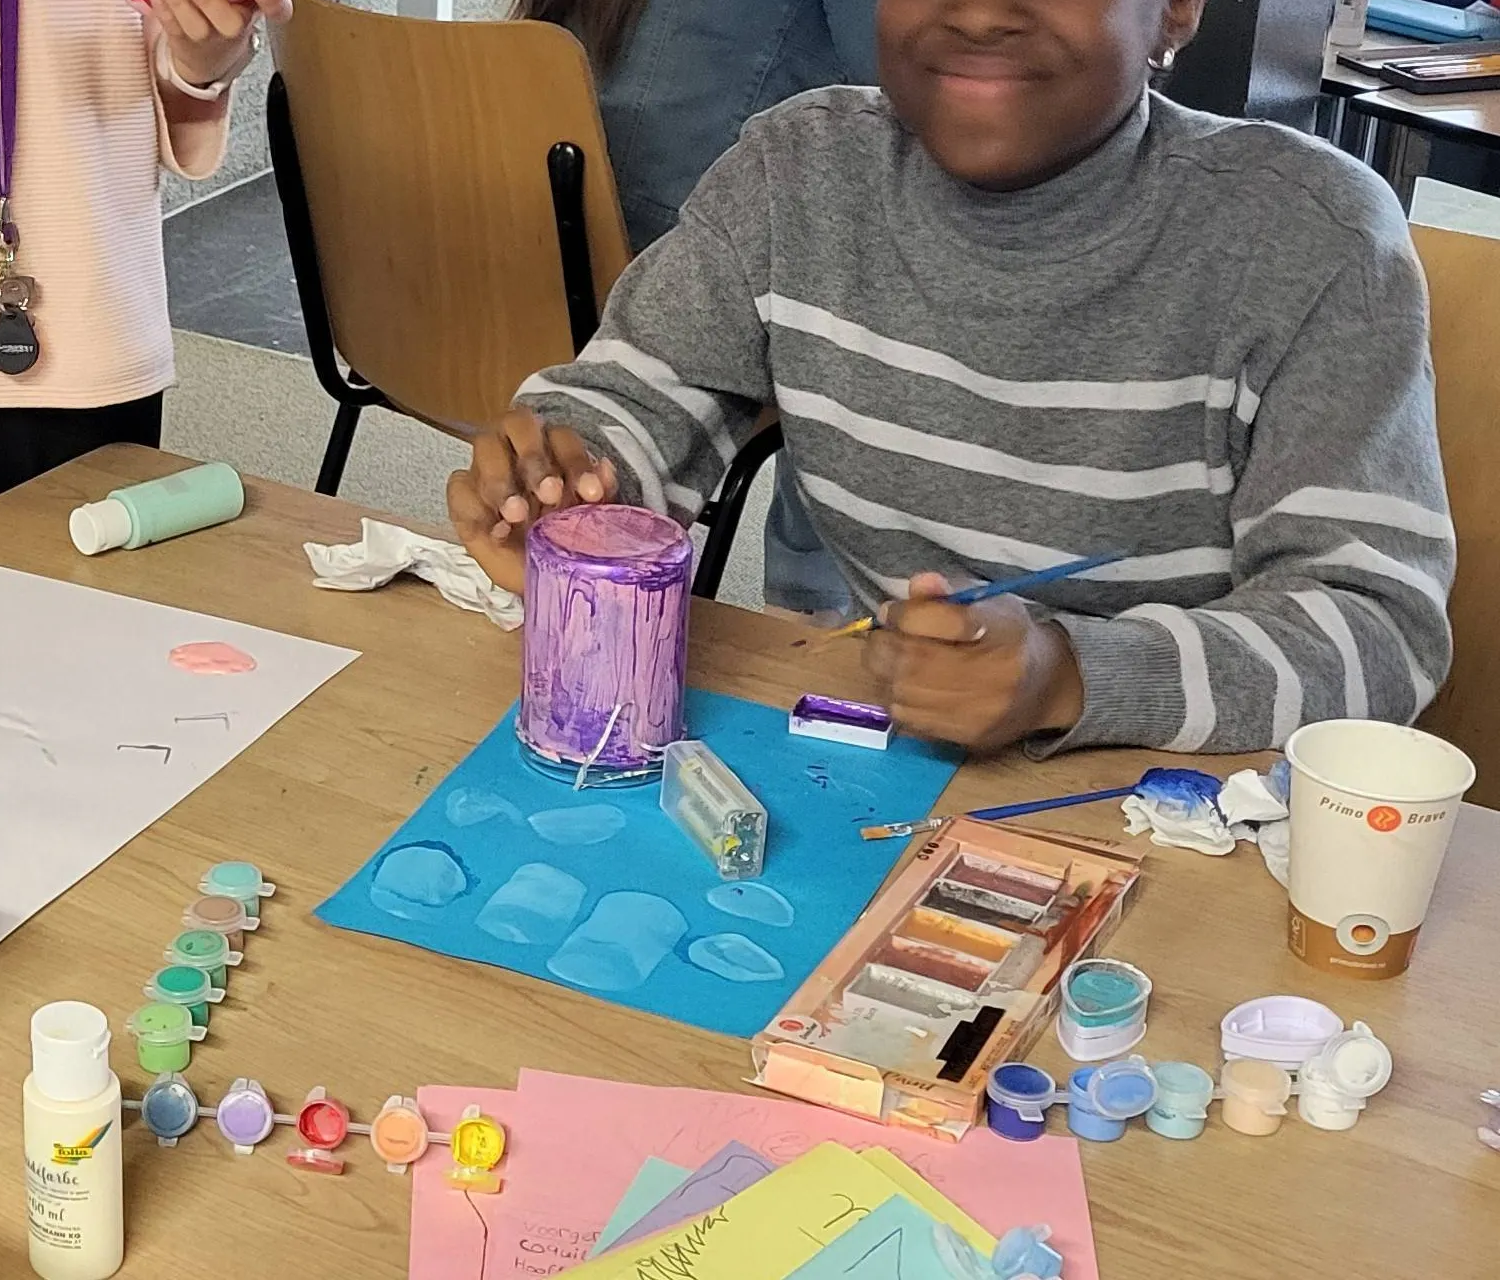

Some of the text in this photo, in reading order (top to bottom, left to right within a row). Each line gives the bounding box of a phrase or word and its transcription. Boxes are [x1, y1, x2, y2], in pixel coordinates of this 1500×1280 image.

[1319, 796, 1446, 825] Primo Bravo
[57, 1147, 89, 1156] folia
[48, 1208, 66, 1222] ml
